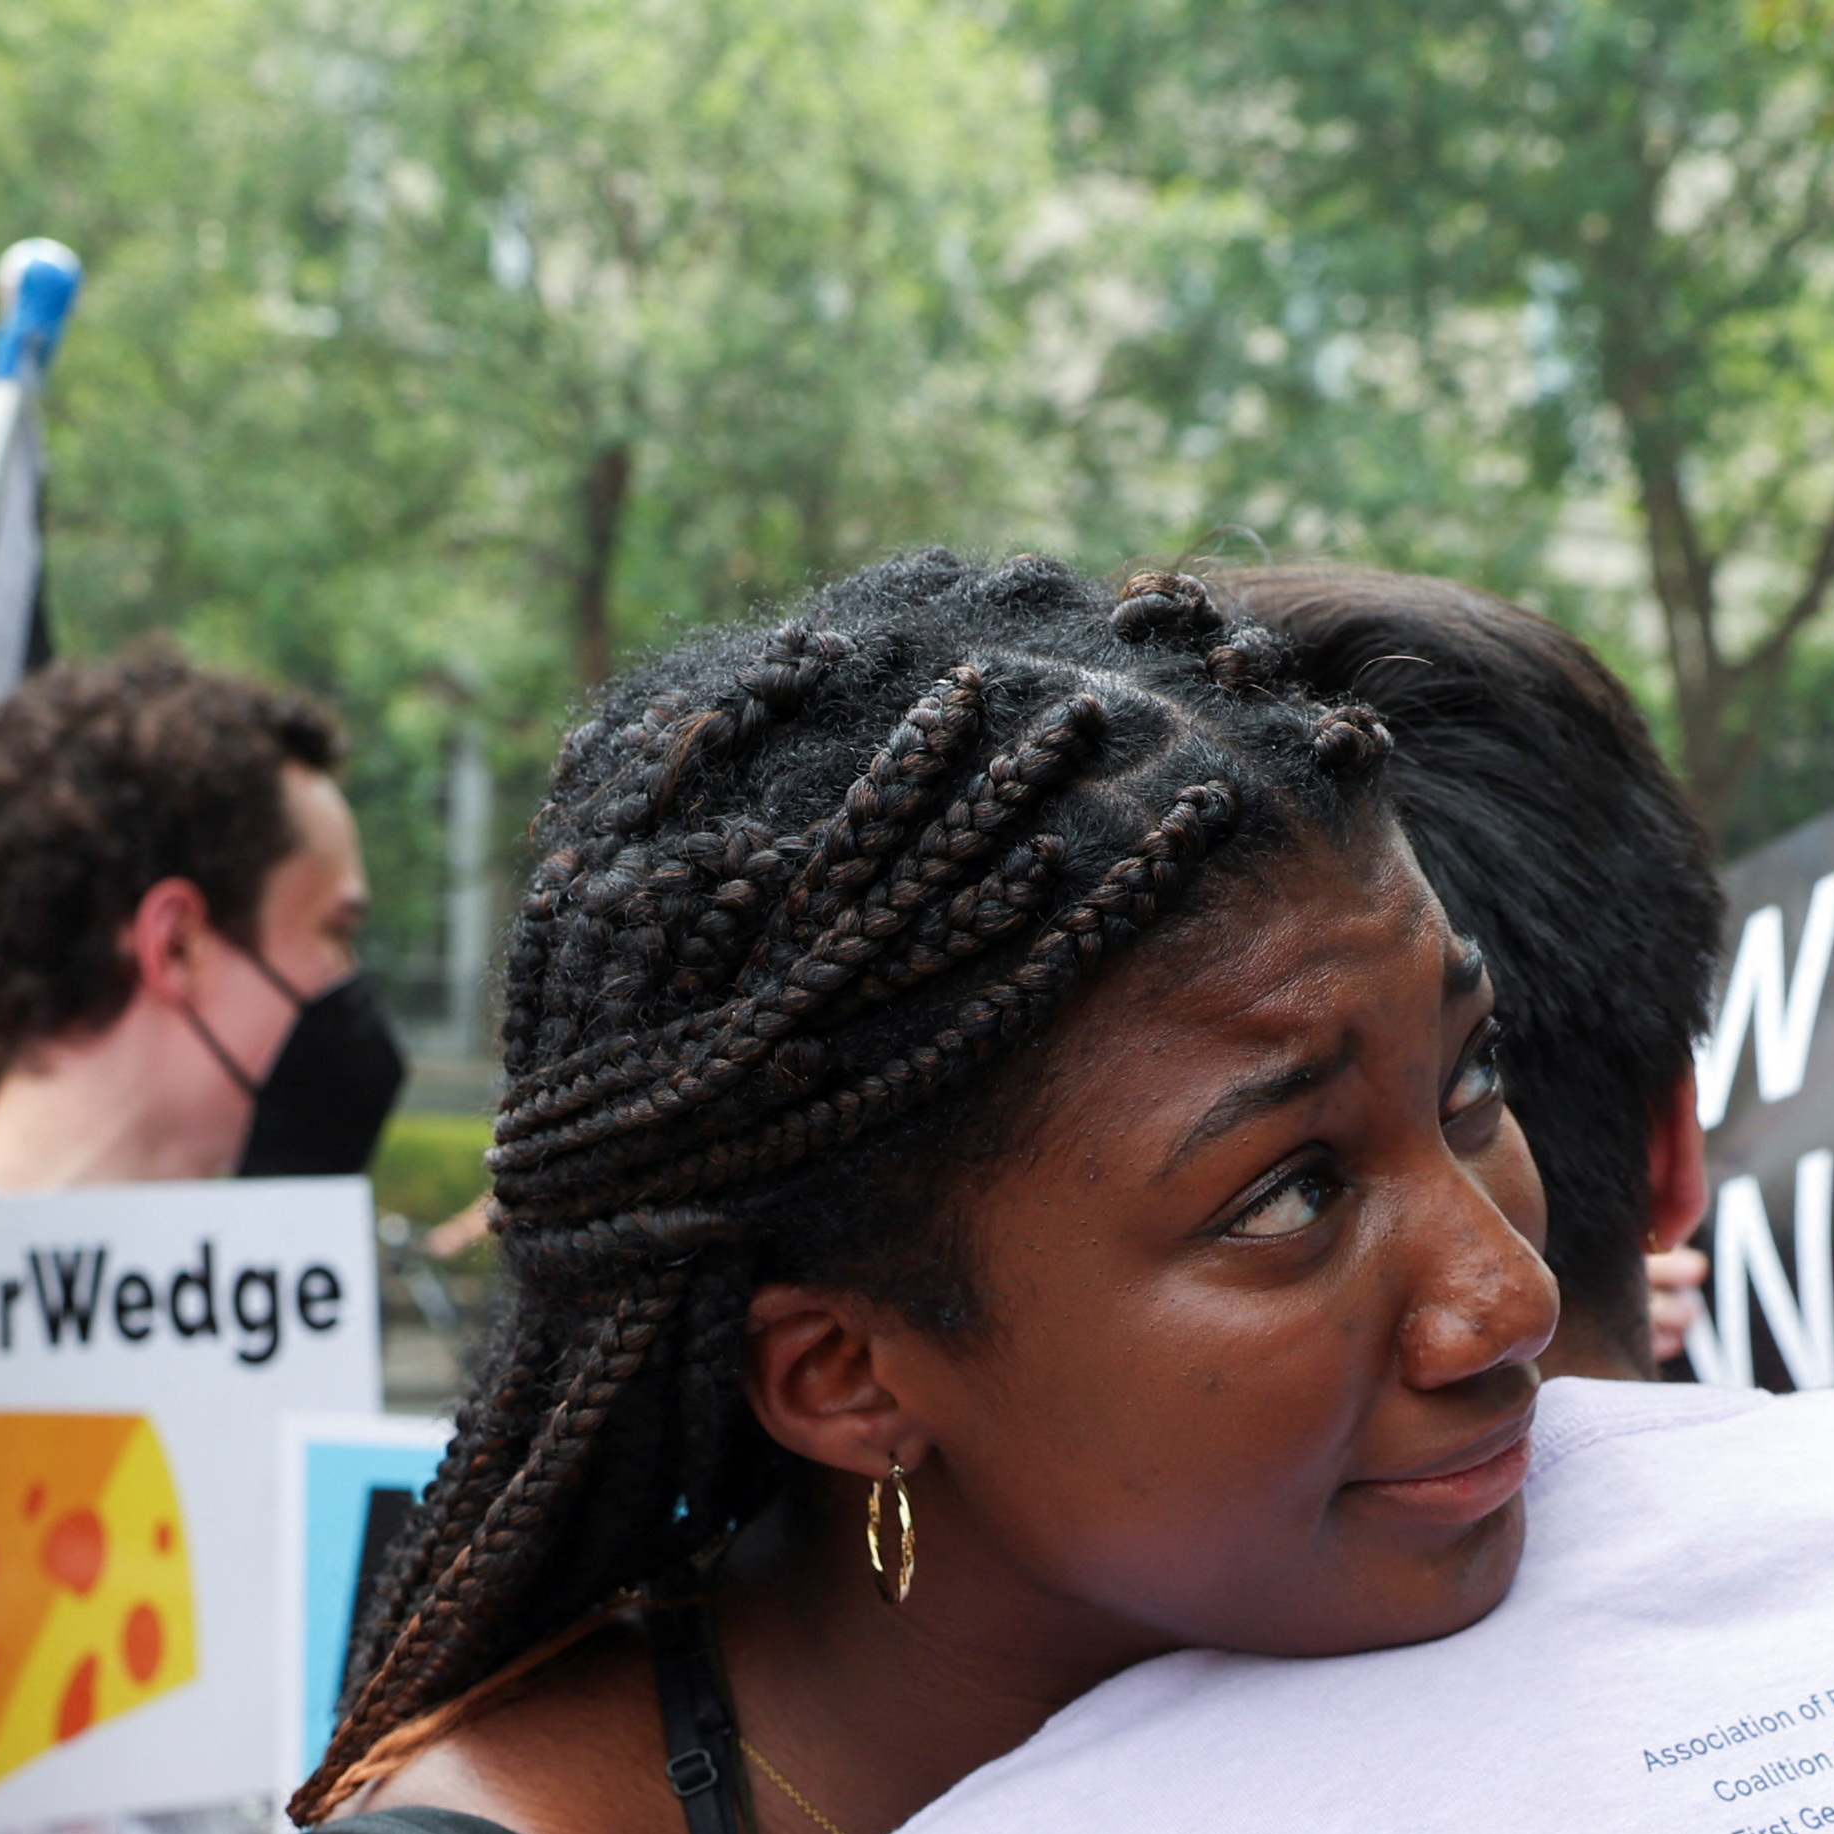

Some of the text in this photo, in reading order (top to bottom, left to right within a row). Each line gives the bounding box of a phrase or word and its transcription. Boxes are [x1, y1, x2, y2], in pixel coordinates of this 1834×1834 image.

[1643, 1709, 1796, 1773] Association
[1799, 1694, 1827, 1721] of
[1713, 1750, 1834, 1802] Coalition
